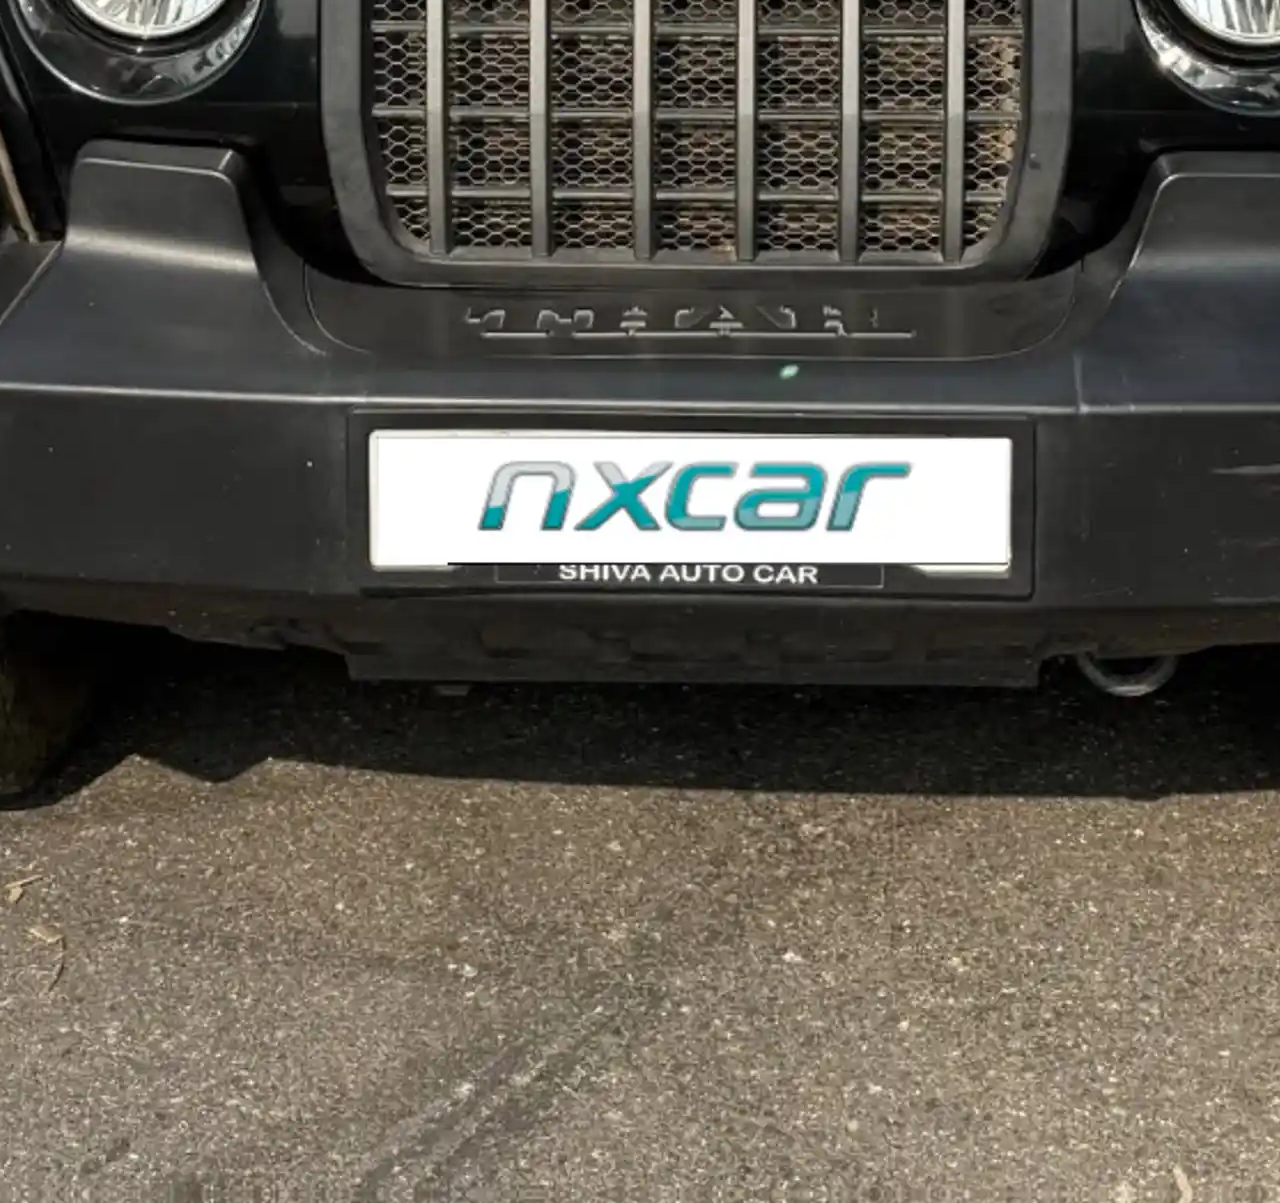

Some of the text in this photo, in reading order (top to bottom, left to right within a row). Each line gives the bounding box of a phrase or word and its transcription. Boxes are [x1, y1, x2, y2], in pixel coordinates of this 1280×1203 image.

[559, 563, 819, 584] SHIVA AUTO CAR
